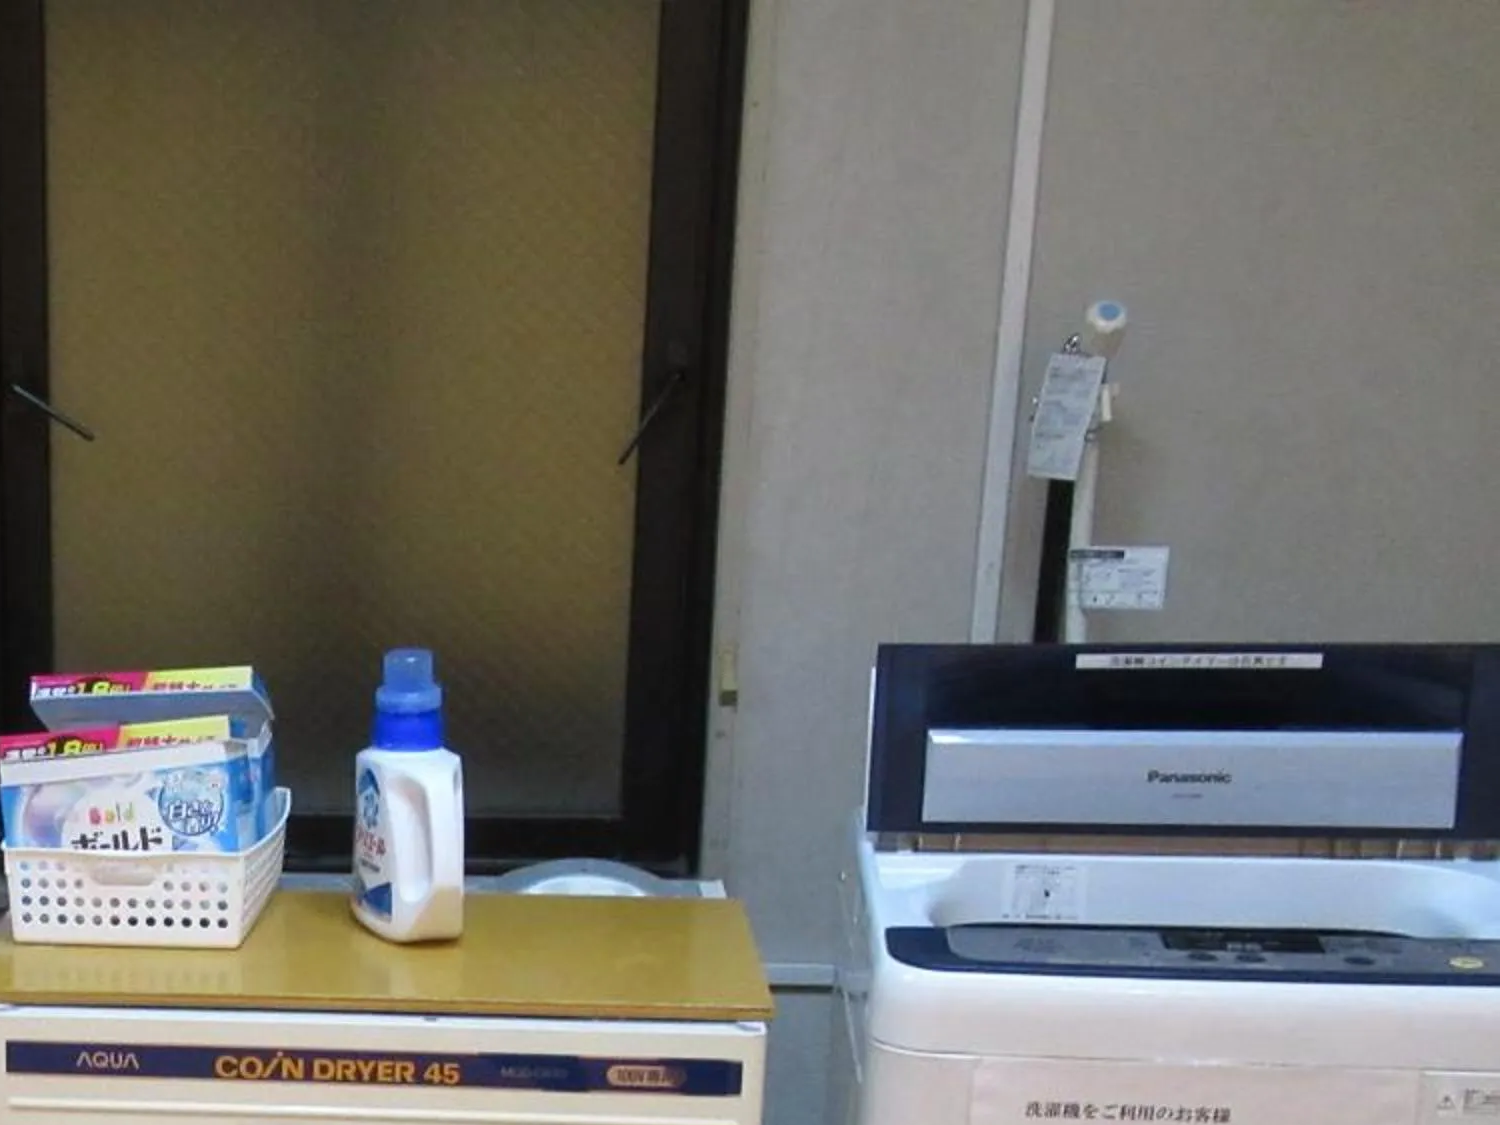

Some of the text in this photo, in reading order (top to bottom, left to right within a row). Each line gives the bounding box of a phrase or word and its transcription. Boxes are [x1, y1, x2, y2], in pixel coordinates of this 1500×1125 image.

[1147, 769, 1233, 785] Panasonic
[71, 826, 164, 851] ボールド
[76, 1050, 140, 1070] AQUA
[313, 1058, 416, 1083] DRYER
[423, 1062, 461, 1085] 45
[1025, 1100, 1232, 1124] 洗濯機をご利用のお客様
